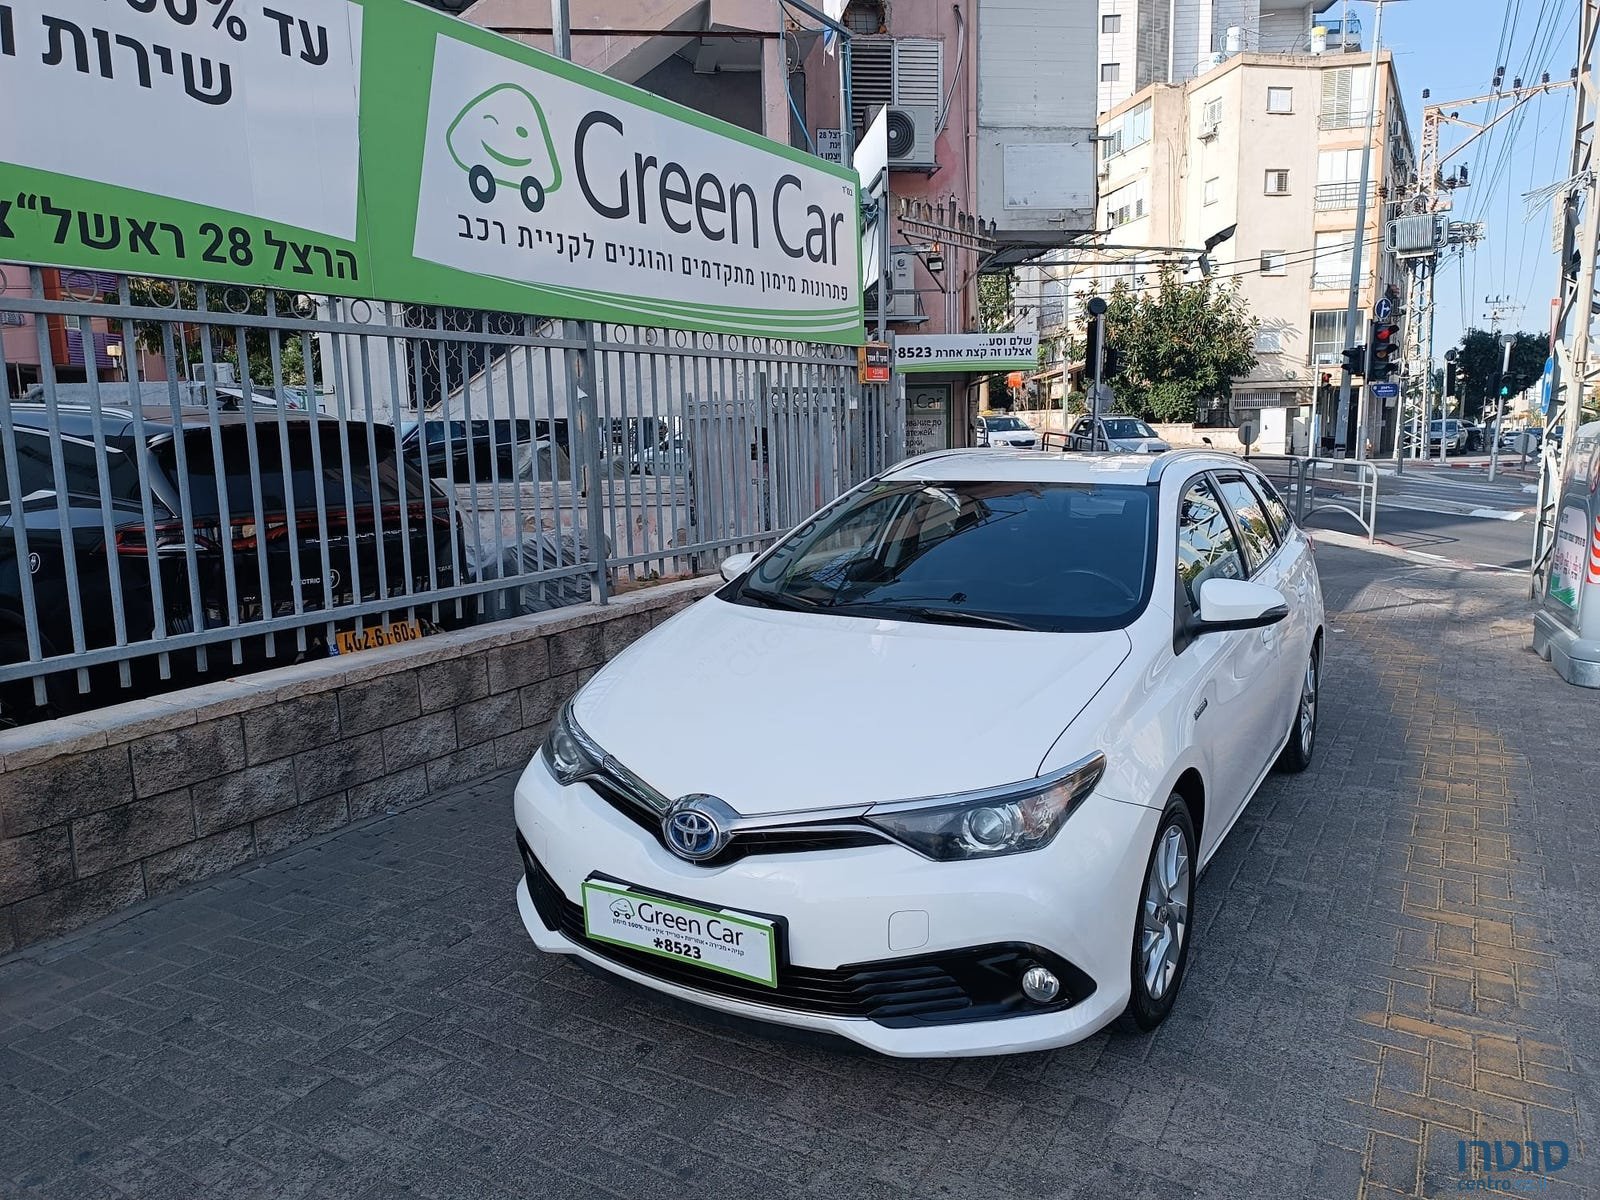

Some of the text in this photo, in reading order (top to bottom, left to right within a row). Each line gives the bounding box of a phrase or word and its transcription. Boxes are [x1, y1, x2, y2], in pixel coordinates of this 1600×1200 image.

[262, 7, 328, 66] עד
[41, 14, 232, 105] שירות
[818, 131, 827, 139] 28
[574, 110, 844, 266] Green Car
[198, 223, 254, 267] 28
[264, 229, 358, 281] הרצל
[458, 214, 848, 301] פתרונות מימון מתקדמים והוגנים לקניית רכב
[1009, 335, 1032, 346] שלם
[935, 349, 962, 358] אחרת
[965, 348, 987, 359] קצת
[990, 348, 1002, 357] זה
[1004, 346, 1032, 357] אצלנו
[916, 393, 943, 409] Car
[628, 921, 644, 930] 100%
[637, 902, 744, 946] Green Car
